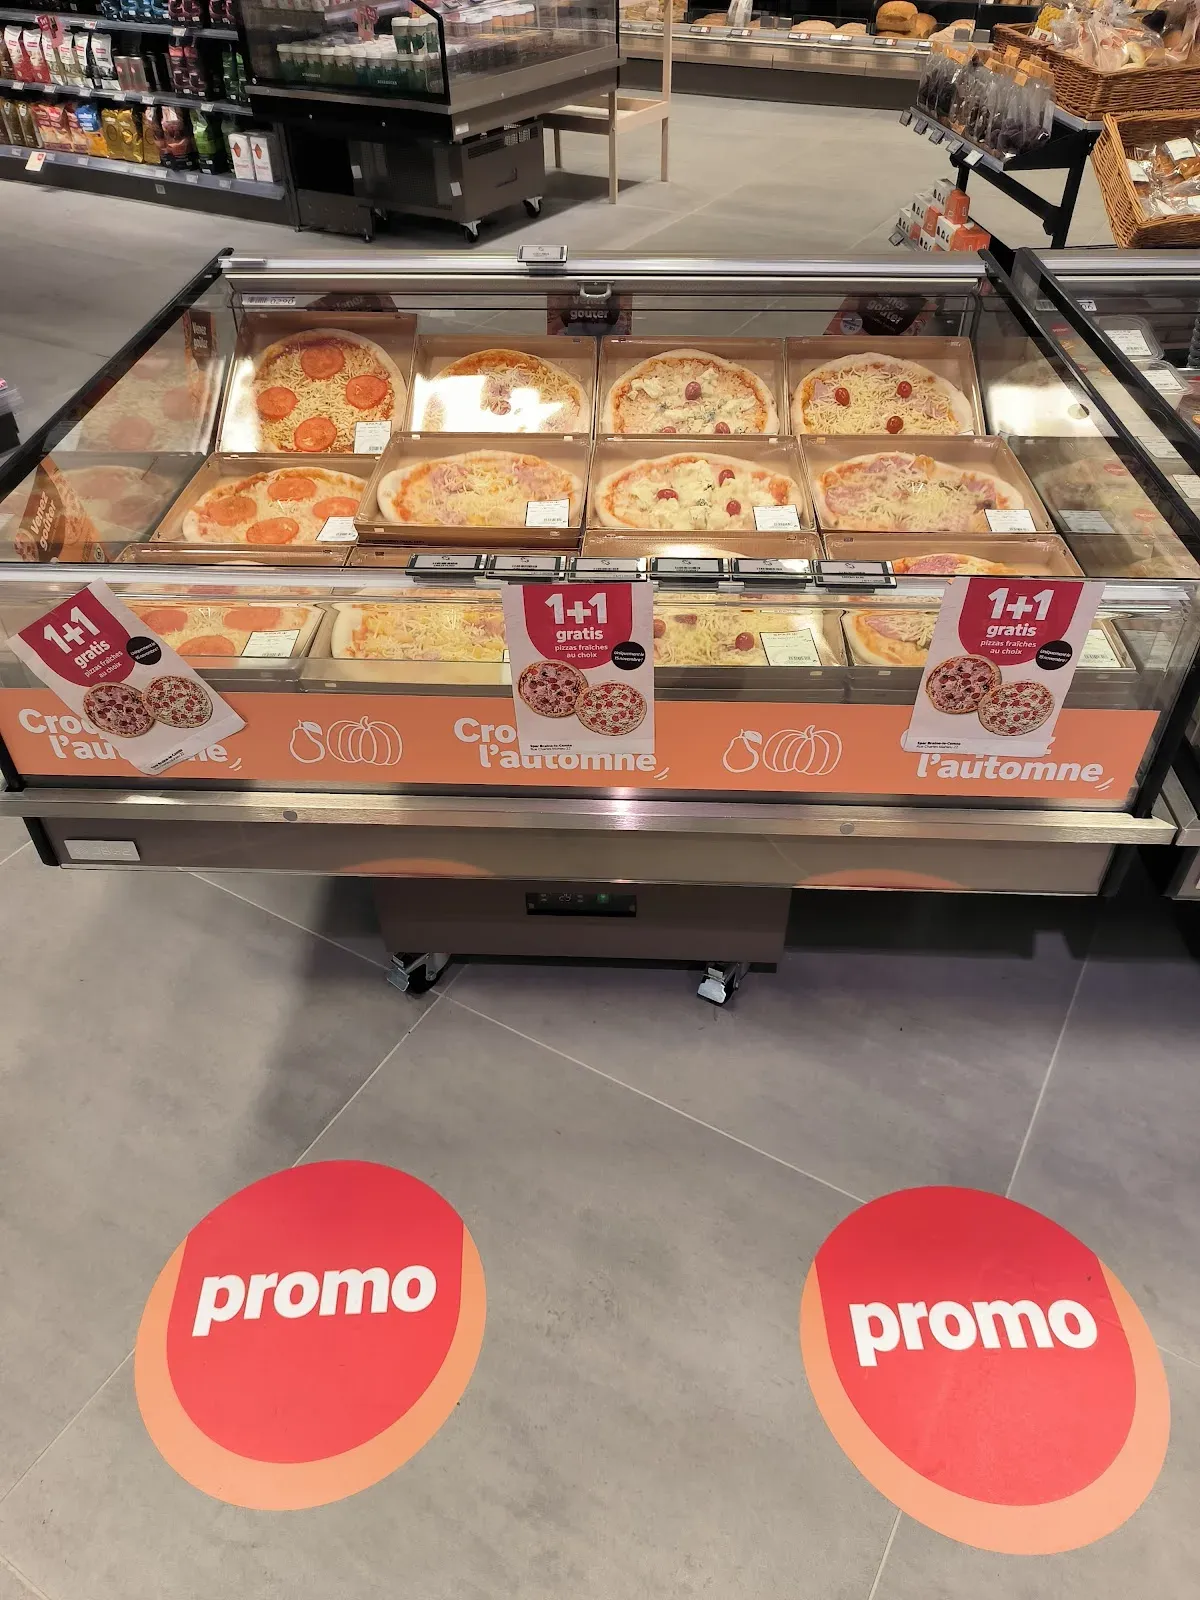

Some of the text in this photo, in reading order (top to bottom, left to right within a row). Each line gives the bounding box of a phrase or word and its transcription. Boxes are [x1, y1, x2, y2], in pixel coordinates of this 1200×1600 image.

[30, 490, 49, 535] Venez
[39, 500, 57, 552] goûter
[544, 592, 608, 624] 1+1
[987, 587, 1055, 621] 1+1
[43, 606, 101, 654] 1+1
[556, 627, 604, 642] gratis
[985, 623, 1037, 638] gratis
[1005, 640, 1037, 648] fraîches
[74, 640, 111, 669] gratis
[554, 644, 577, 652] pizzas
[84, 650, 124, 678] pizzas fraîches
[106, 661, 122, 674] choix
[916, 753, 1104, 782] l'automne
[192, 1265, 437, 1337] promo
[849, 1299, 1097, 1367] promo
